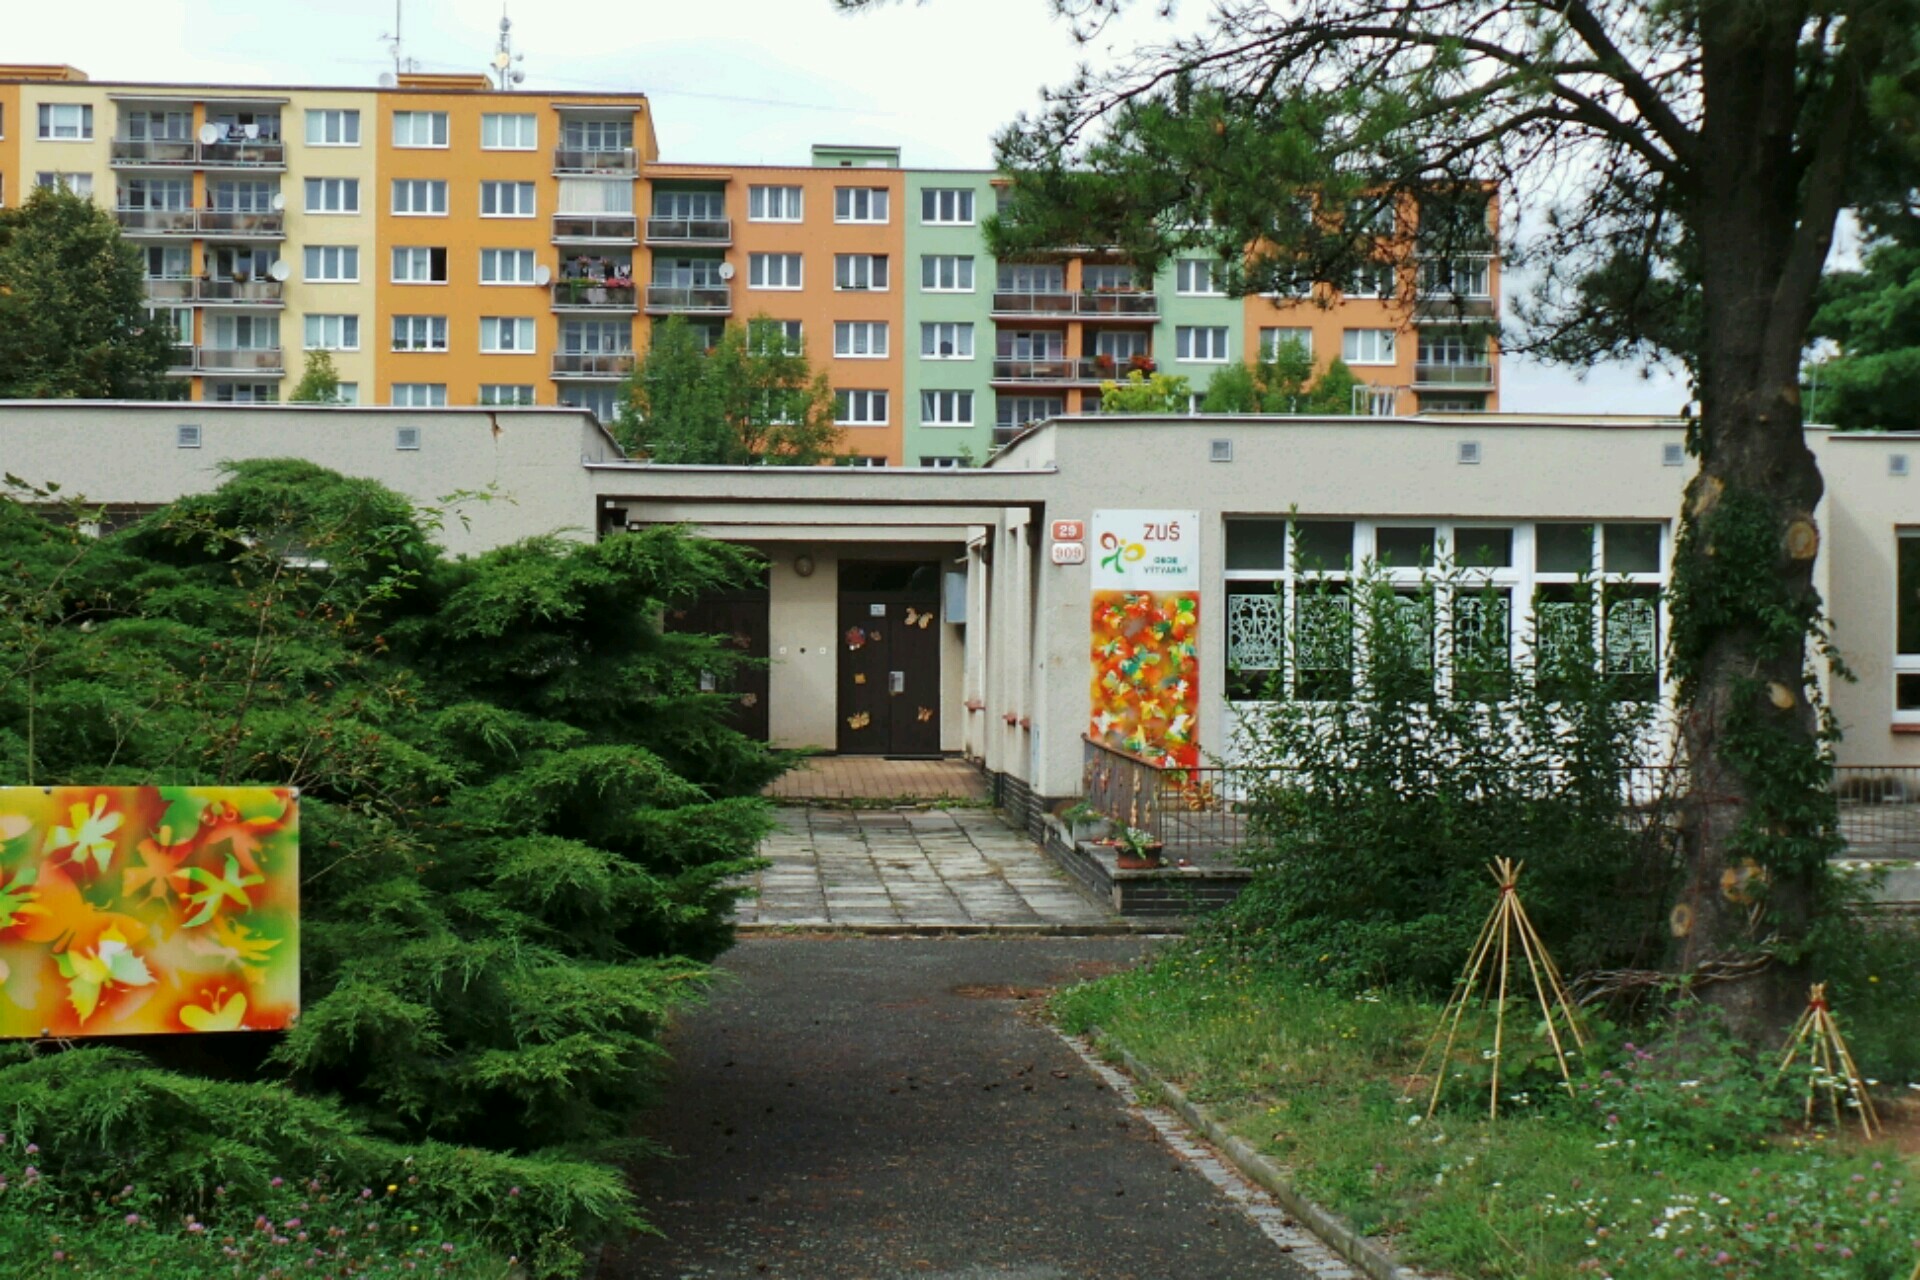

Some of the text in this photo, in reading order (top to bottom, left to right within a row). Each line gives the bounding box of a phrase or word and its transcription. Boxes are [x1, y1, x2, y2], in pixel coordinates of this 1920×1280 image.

[1059, 525, 1077, 537] 29
[1143, 521, 1180, 541] ZUŠ
[1055, 547, 1082, 559] 909
